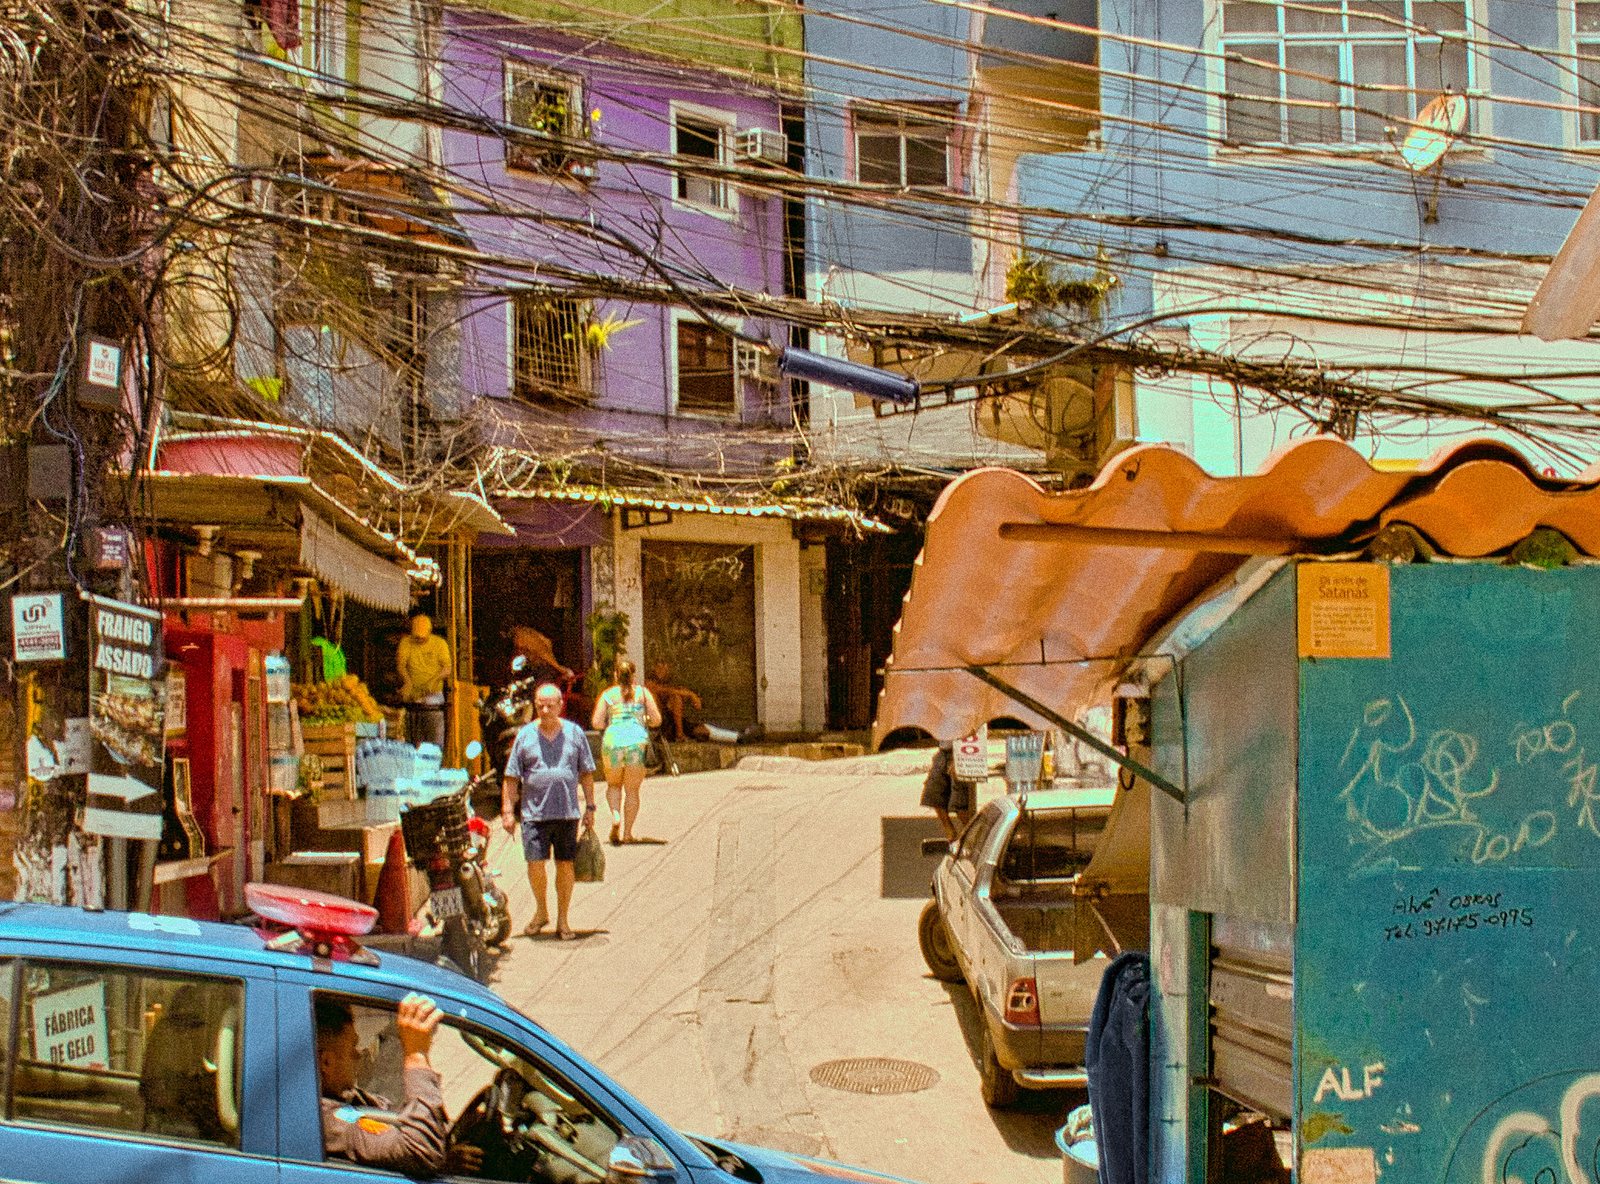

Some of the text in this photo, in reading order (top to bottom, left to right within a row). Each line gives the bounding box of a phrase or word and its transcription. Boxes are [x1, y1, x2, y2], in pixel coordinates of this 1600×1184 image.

[97, 609, 153, 646] FRANGO
[95, 643, 153, 679] ASSADO
[45, 1005, 95, 1036] FÁBRICA
[50, 1034, 95, 1064] DE GELO
